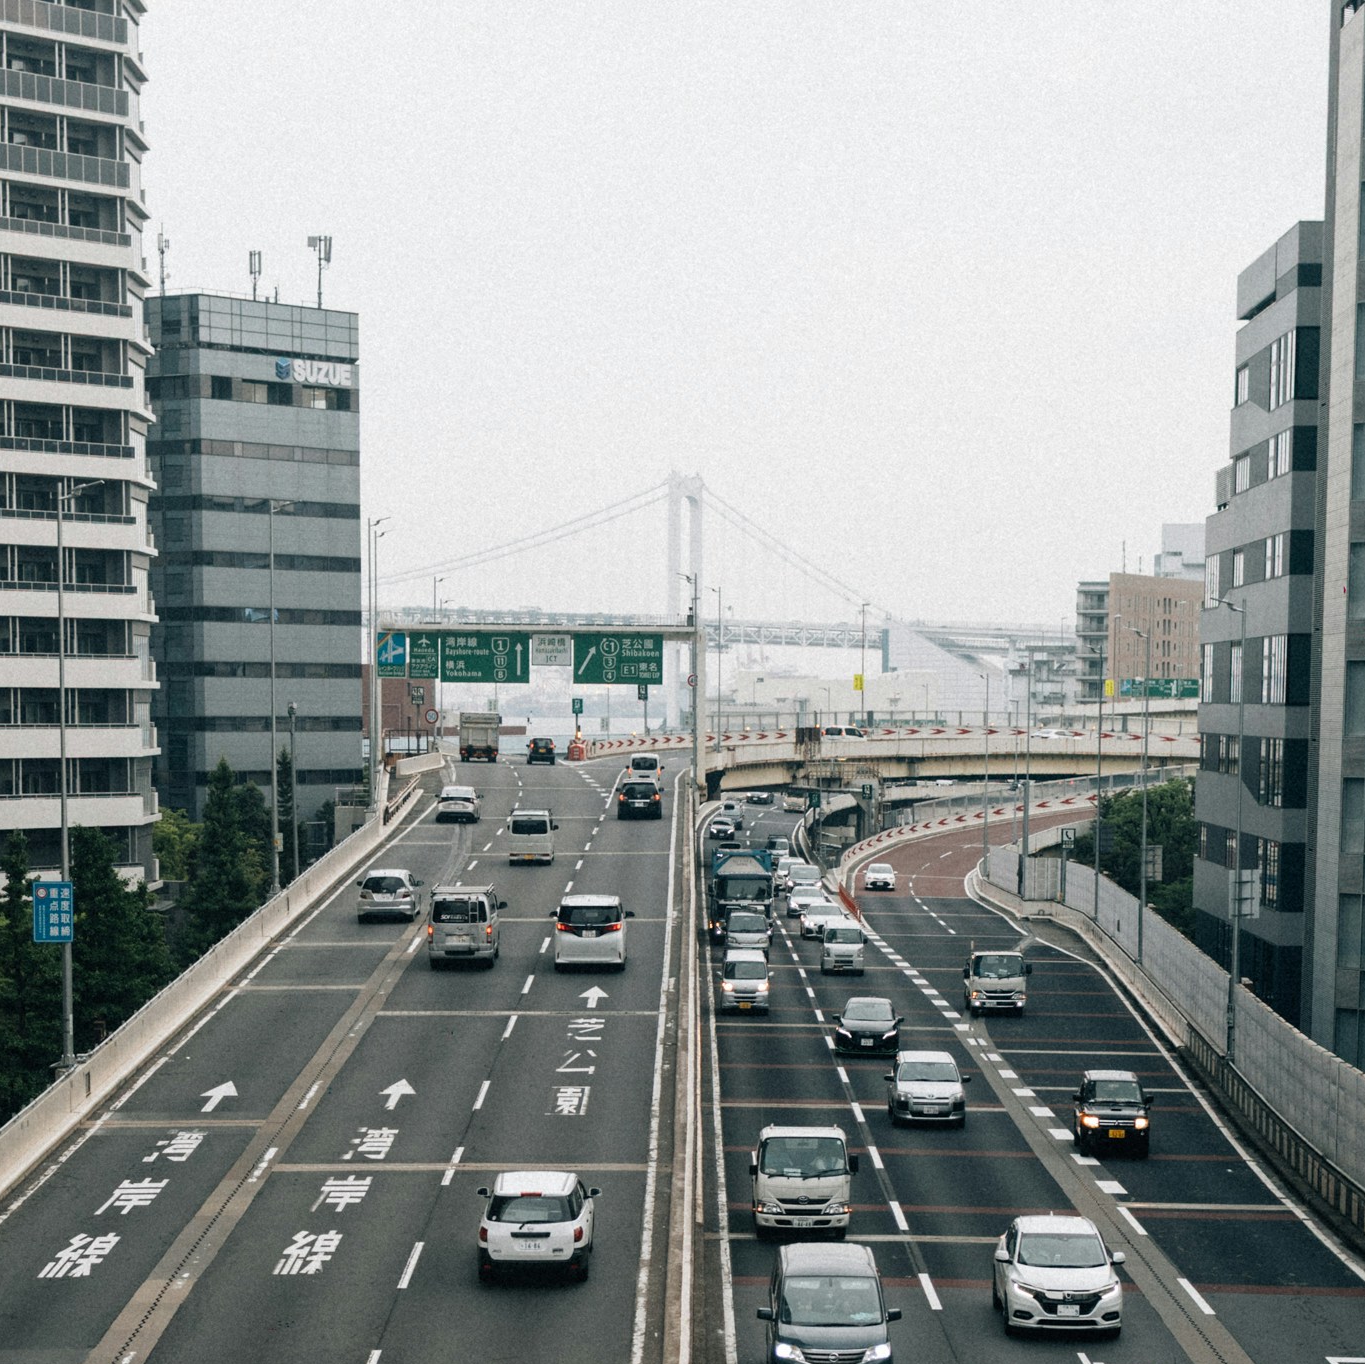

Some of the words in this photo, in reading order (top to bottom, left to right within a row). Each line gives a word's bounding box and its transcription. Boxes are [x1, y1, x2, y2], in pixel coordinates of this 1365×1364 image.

[293, 359, 351, 385] SUZUE
[446, 637, 477, 647] 湾岸線
[497, 640, 504, 650] 1
[603, 642, 615, 652] C1
[622, 639, 654, 649] 芝公園
[546, 655, 557, 663] JCT
[446, 660, 465, 669] 横浜
[639, 663, 658, 671] 東名
[624, 666, 635, 674] E1
[49, 888, 59, 936] 重点路線
[544, 1018, 605, 1116] 芝公園
[36, 1128, 209, 1278] 湾岸線
[272, 1126, 400, 1275] 湾岸線
